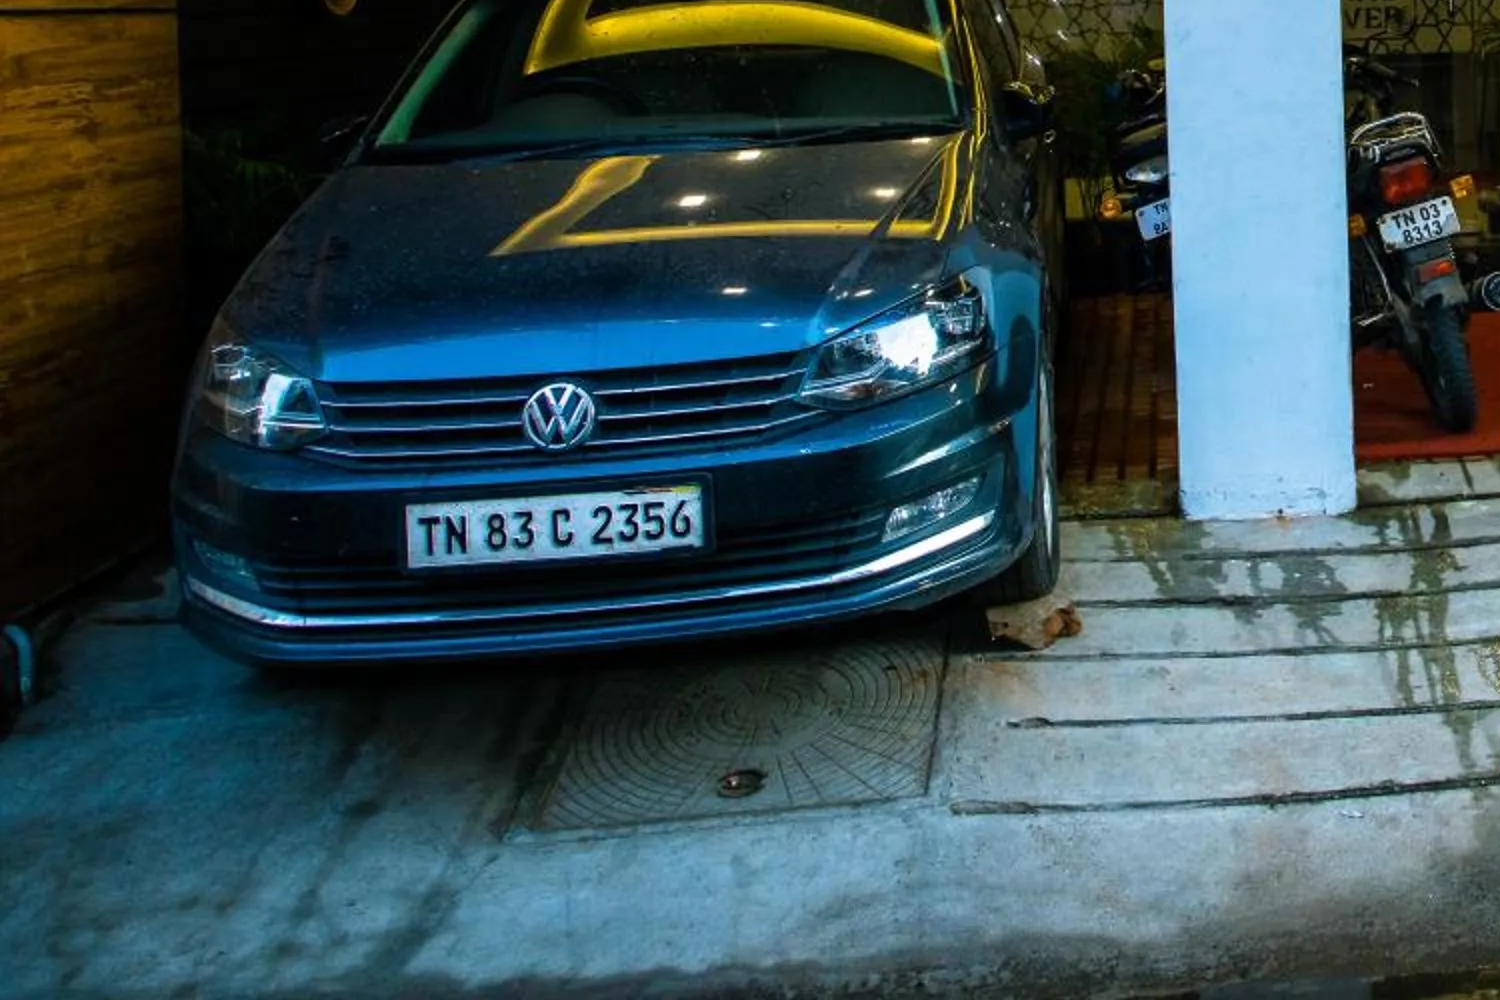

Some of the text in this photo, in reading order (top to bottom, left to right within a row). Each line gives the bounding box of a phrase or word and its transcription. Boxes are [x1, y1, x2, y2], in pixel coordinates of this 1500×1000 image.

[1392, 203, 1441, 229] TN 03
[1403, 220, 1443, 243] 8313
[417, 499, 691, 556] TN 83 C 2356
